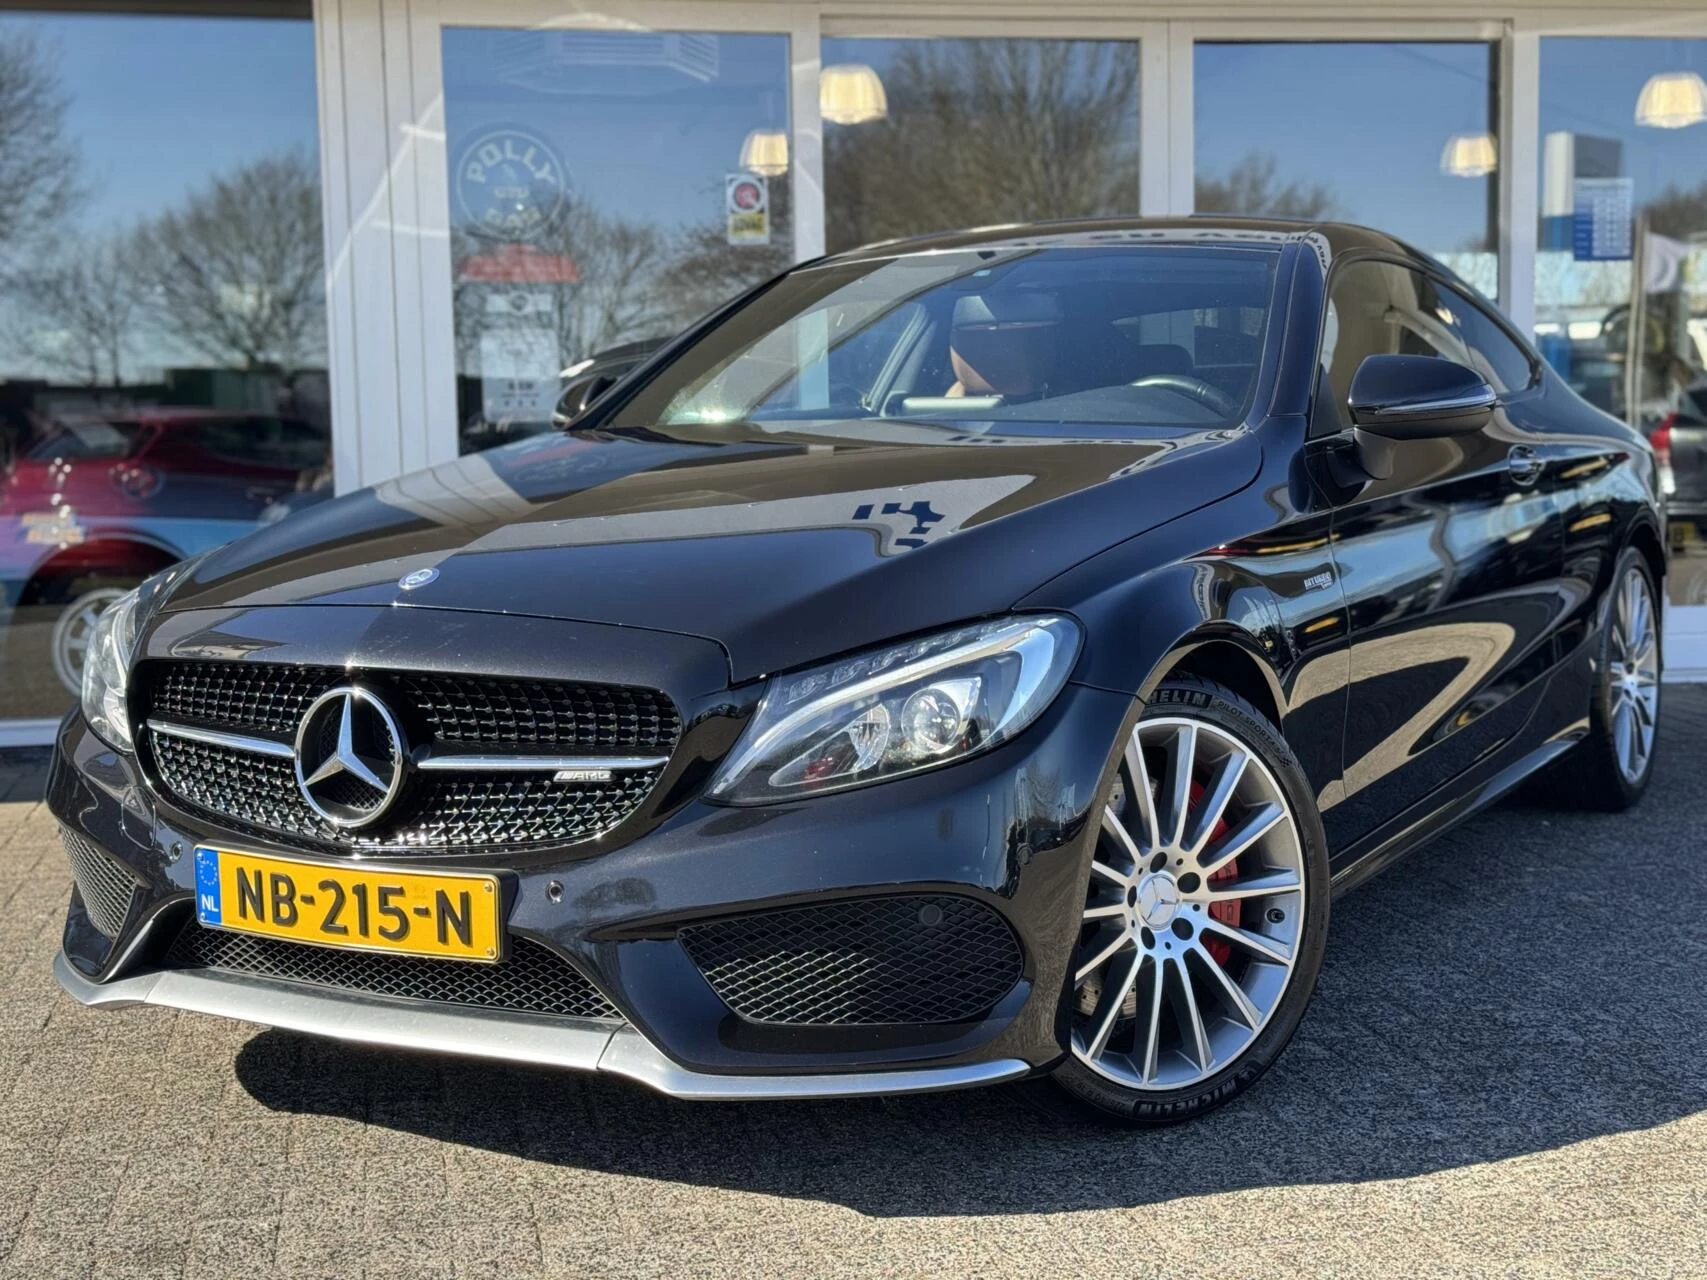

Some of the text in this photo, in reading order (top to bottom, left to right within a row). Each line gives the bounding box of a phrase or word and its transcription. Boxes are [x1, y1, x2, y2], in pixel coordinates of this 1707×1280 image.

[466, 138, 556, 184] POLLY
[1149, 690, 1206, 706] HELIN
[201, 894, 219, 912] NL
[236, 867, 473, 948] NB-215-N
[1139, 1080, 1237, 1116] MICHELIN
